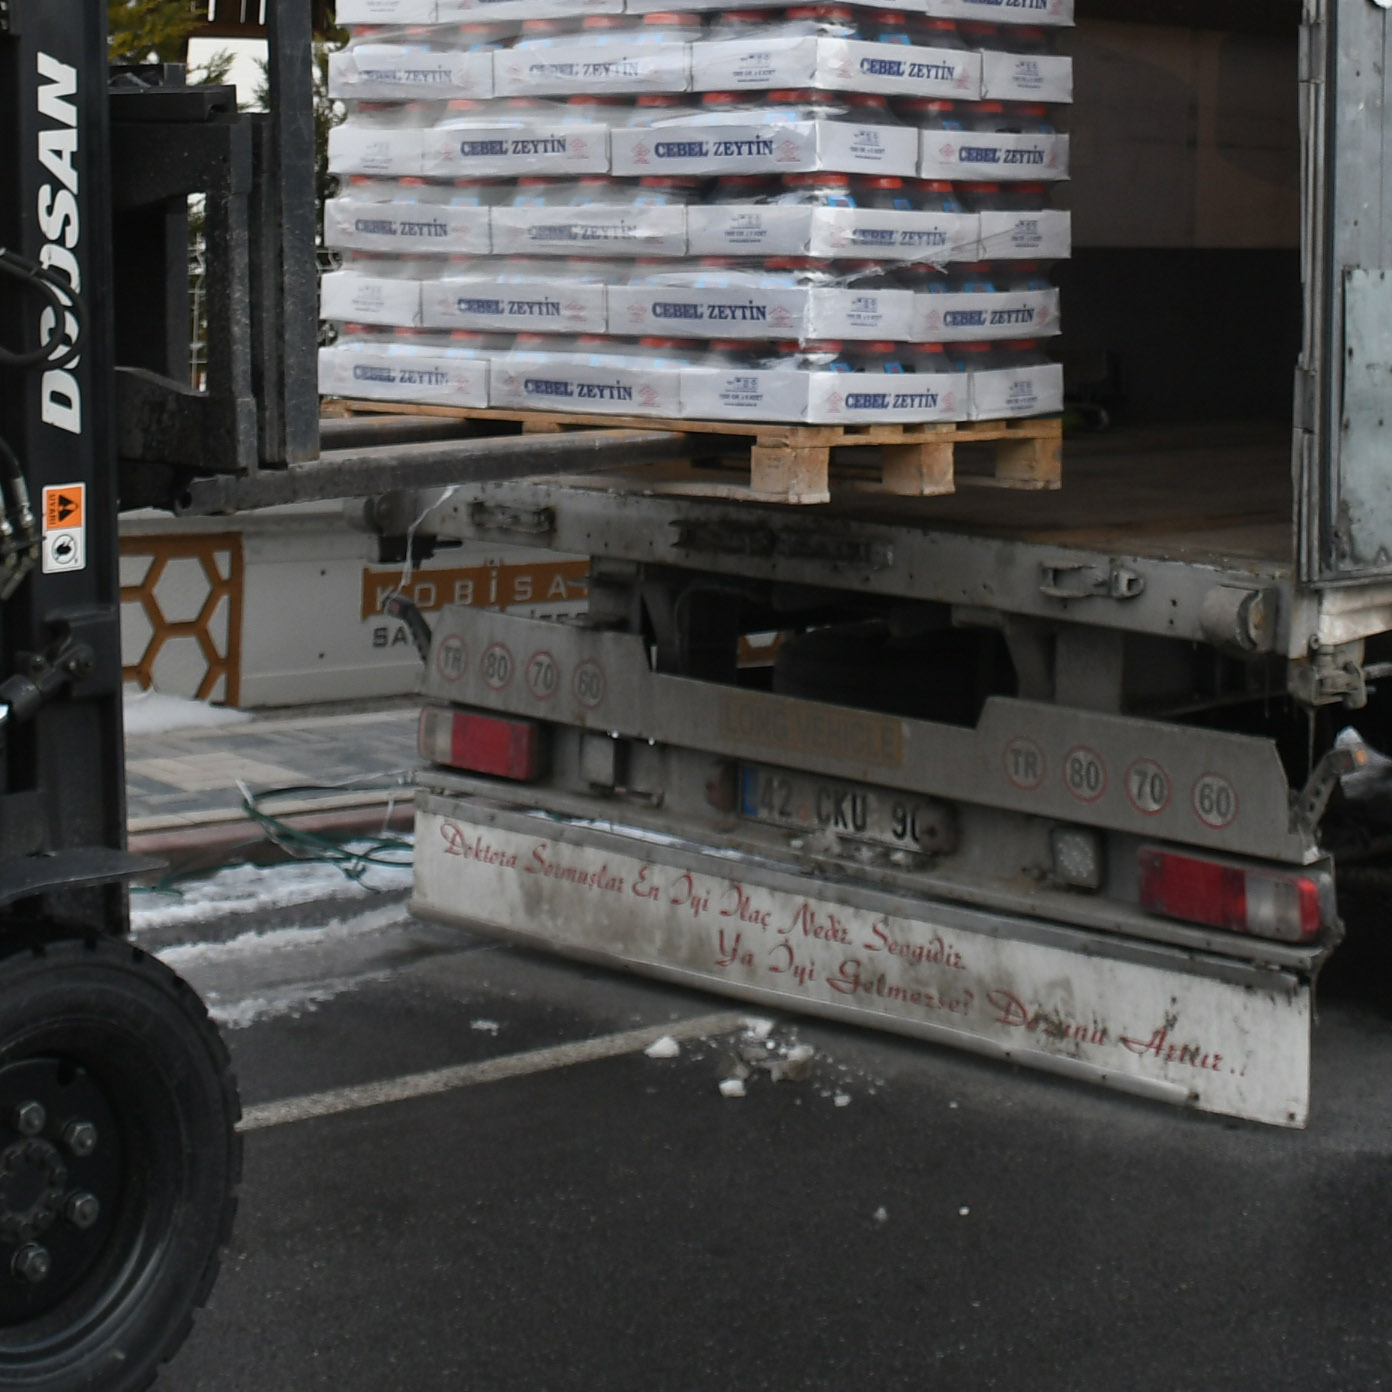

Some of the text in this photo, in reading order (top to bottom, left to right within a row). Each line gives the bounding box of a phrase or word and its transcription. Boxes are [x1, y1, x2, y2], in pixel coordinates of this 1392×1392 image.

[404, 64, 452, 83] ZEYTİN
[860, 58, 954, 80] CEBEL ZEYTİN
[461, 133, 566, 156] CEBEL ZEYTİN
[655, 134, 773, 158] CEBEL ZEYTİN
[959, 145, 1045, 164] CEBEL ZEYTİN
[354, 217, 447, 237] CEBEL ZEYTİN
[458, 296, 560, 316] CEBEL ZEYTİN
[652, 300, 766, 320] CEBEL ZEYTİN
[943, 304, 1034, 326] CEBEL ZEYTİN
[524, 379, 632, 400] CEBEL ZEYTİN
[845, 388, 938, 409] CEBEL ZEYTİN
[376, 559, 589, 611] KOBİSA
[487, 653, 507, 682] 80
[533, 662, 553, 690] 70
[578, 669, 600, 700] 60
[1012, 748, 1038, 780] TR
[1071, 758, 1100, 791] 80
[1134, 769, 1164, 804] 70
[816, 785, 868, 832] CKU
[1200, 783, 1230, 818] 60
[440, 822, 517, 868] Doktora
[525, 843, 624, 893] Sormuşlar
[632, 865, 660, 901] En
[714, 929, 754, 967] Ya
